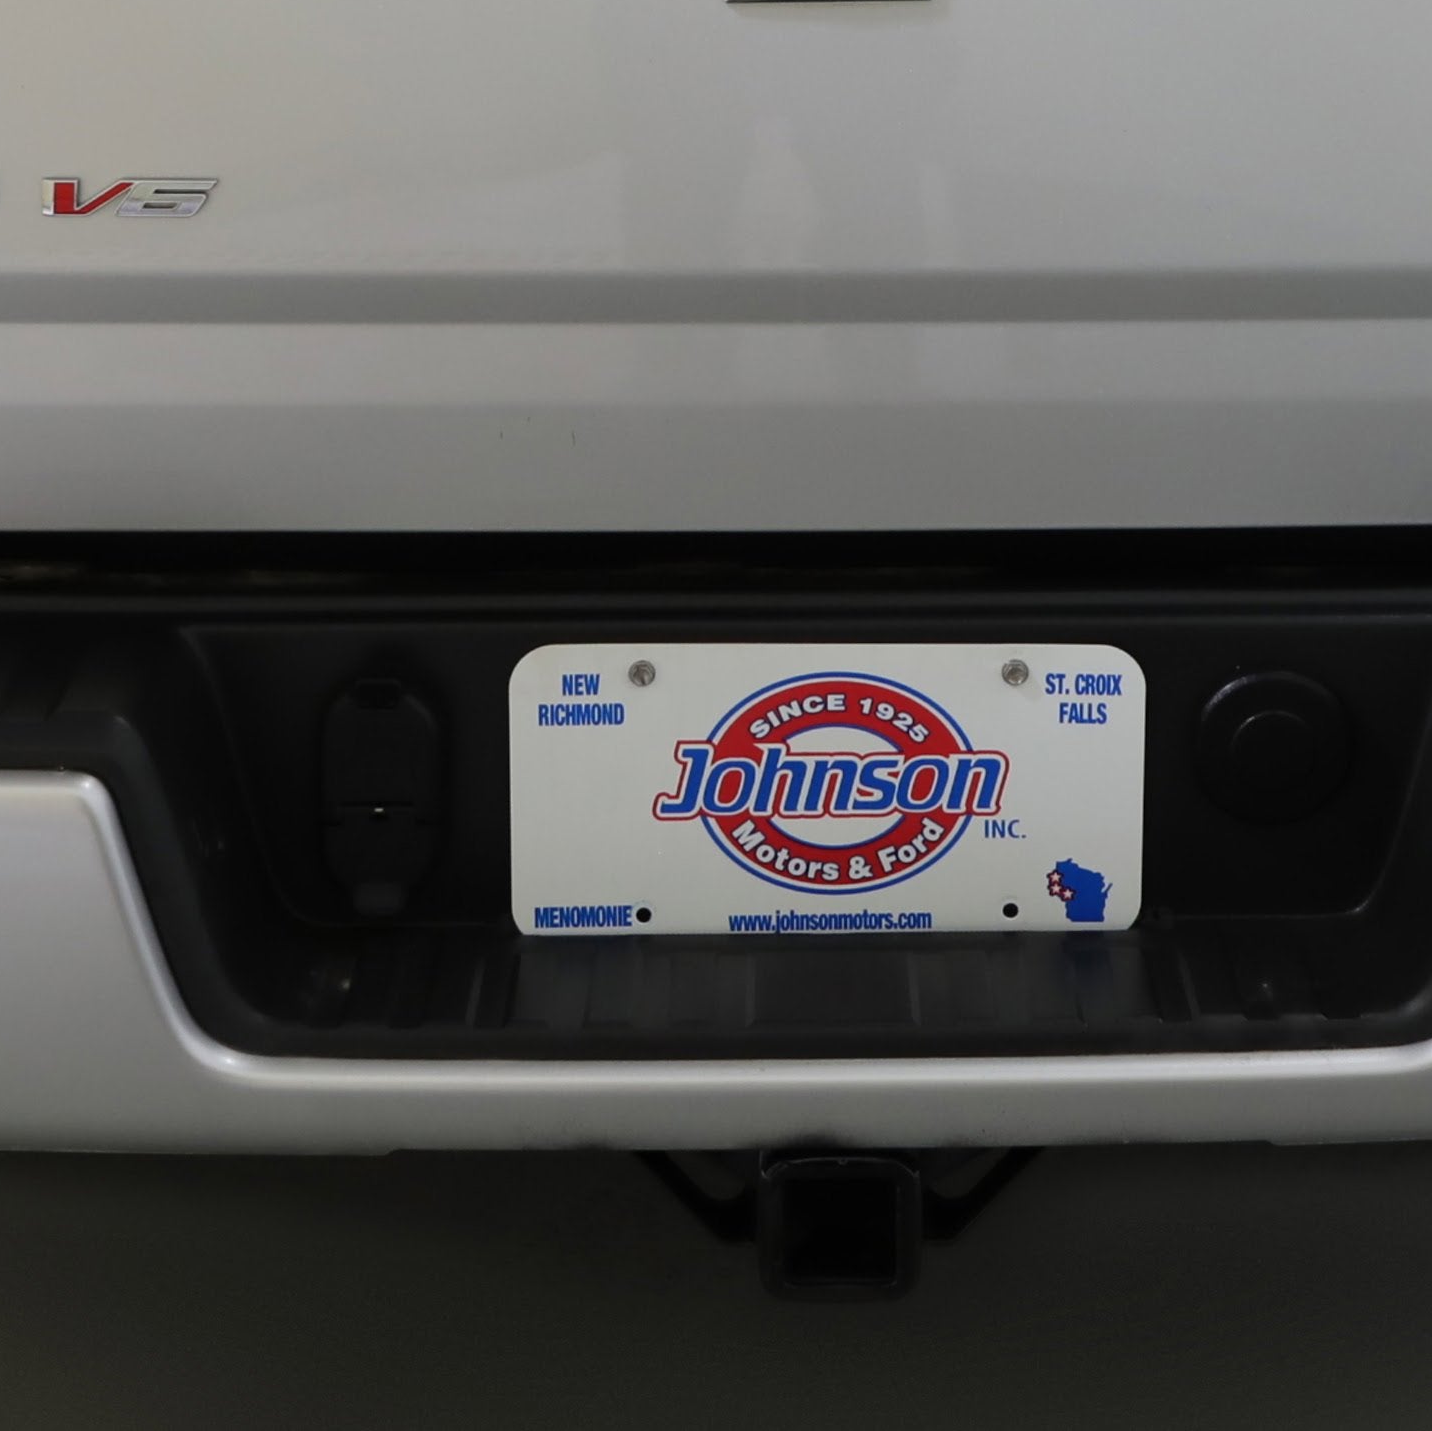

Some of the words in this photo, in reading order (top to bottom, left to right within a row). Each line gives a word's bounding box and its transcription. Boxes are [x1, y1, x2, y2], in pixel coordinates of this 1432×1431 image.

[42, 176, 218, 217] V6
[562, 674, 600, 696] NEW
[1045, 673, 1071, 695] ST.
[1075, 673, 1122, 696] CROIX
[538, 703, 625, 726] RICHMOND
[749, 693, 846, 739] SINCE
[860, 698, 929, 743] 1925
[1059, 702, 1107, 724] FALLS
[659, 746, 1002, 814] Johnson
[984, 819, 1027, 839] INC.
[732, 821, 839, 880] Motors
[848, 857, 873, 879] &
[877, 819, 945, 873] Ford
[534, 907, 633, 929] MENOMONIE
[728, 910, 932, 933] www.johnsonmotors.com
